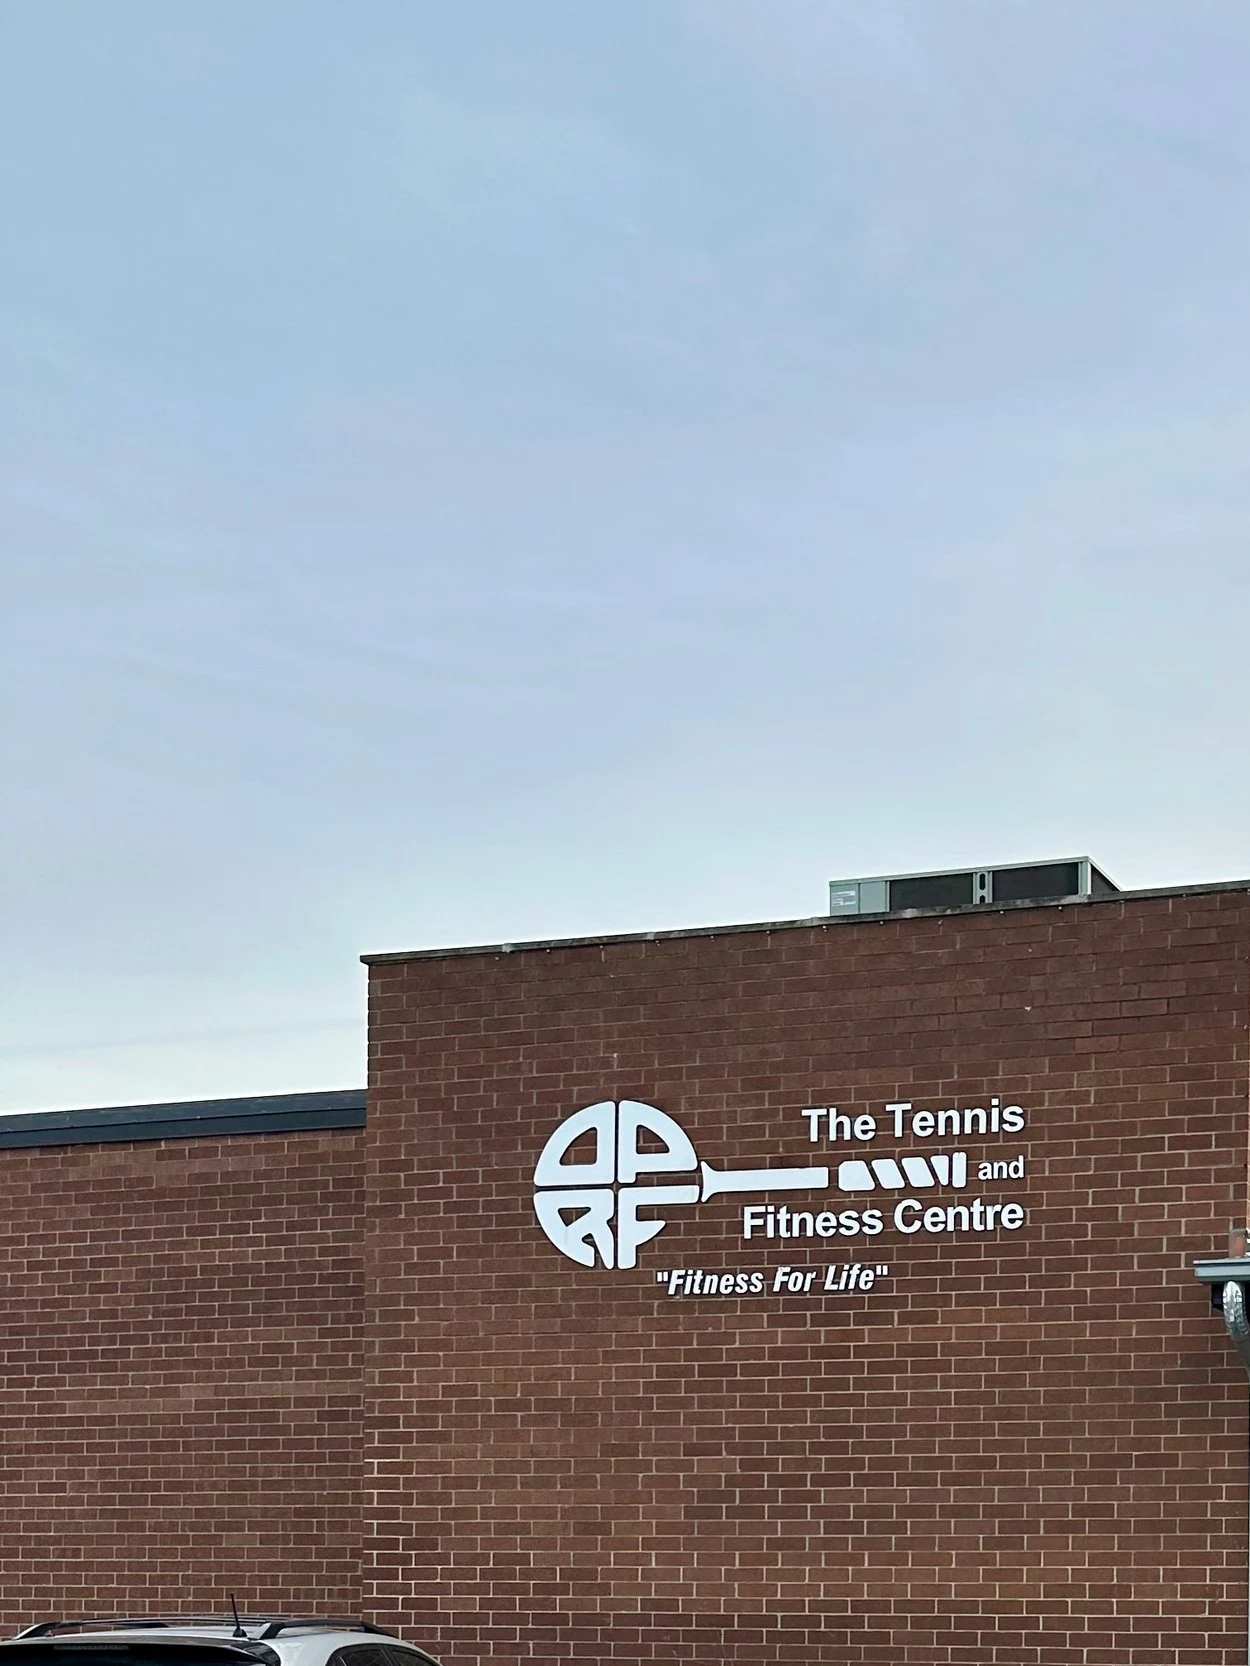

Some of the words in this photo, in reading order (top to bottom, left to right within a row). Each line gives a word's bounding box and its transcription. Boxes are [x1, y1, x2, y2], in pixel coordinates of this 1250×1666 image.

[801, 1107, 877, 1142] The
[885, 1098, 1026, 1138] Tennis
[977, 1155, 1025, 1181] and
[743, 1204, 884, 1240] Fitness
[893, 1198, 1025, 1235] Centre
[656, 1269, 764, 1296] "Fitness
[772, 1266, 816, 1292] For
[823, 1263, 889, 1291] Life"
